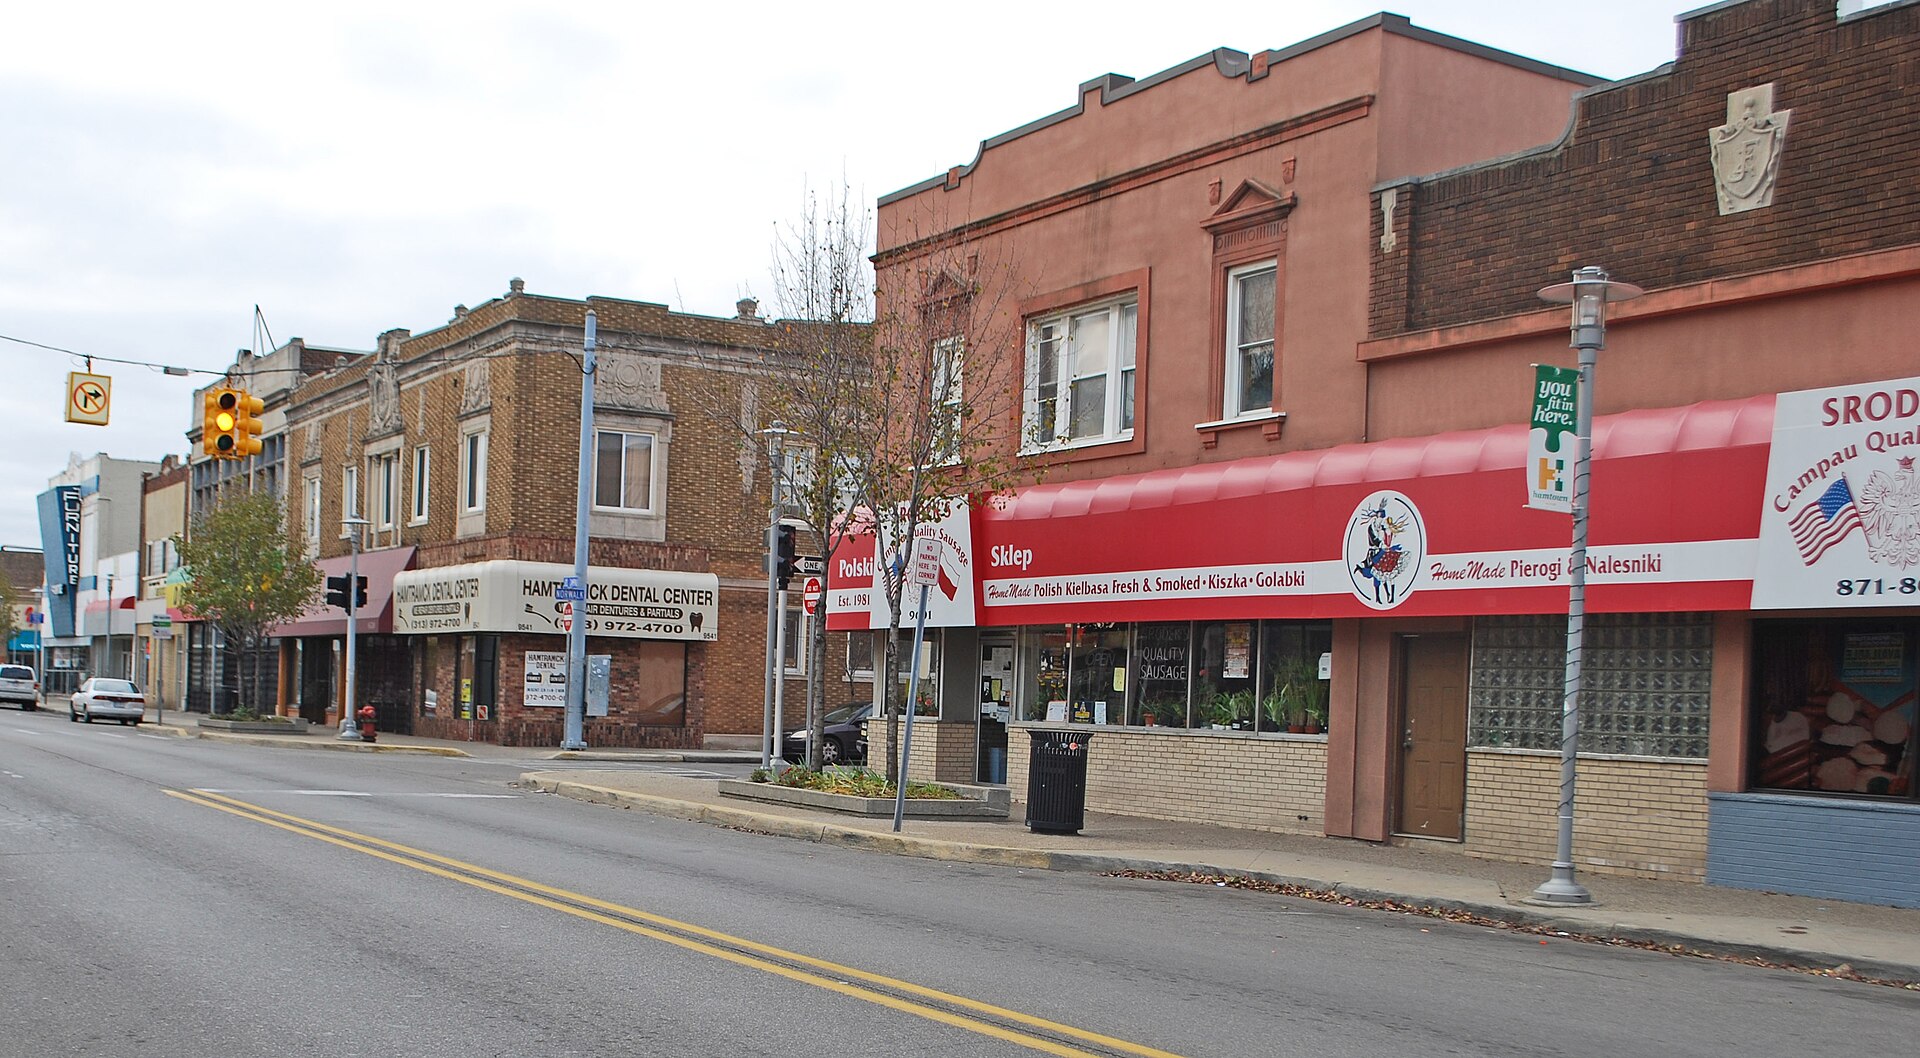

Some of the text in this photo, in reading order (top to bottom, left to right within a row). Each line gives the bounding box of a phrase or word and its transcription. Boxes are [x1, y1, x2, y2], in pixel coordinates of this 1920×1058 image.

[1538, 380, 1572, 399] you
[1546, 396, 1574, 412] fit in
[1822, 389, 1920, 427] SROD
[1534, 404, 1573, 426] here.
[1774, 444, 1858, 513] Campau
[1533, 490, 1568, 502] hamtown
[63, 491, 82, 586] FURNITURE
[913, 525, 936, 541] uality
[939, 527, 969, 568] Sausage
[804, 561, 819, 570] ONE
[919, 553, 938, 562] PARKING
[990, 544, 1033, 571] Sklep
[838, 556, 874, 578] Polski
[918, 562, 938, 571] HERE TO
[1510, 557, 1562, 582] Pierogi
[1585, 553, 1662, 576] Nalesniki
[918, 571, 936, 580] CORNER
[455, 578, 480, 599] CENTER
[1033, 582, 1062, 598] Polish
[1065, 580, 1109, 597] Kielbasa
[1112, 577, 1139, 594] Fresh
[1142, 577, 1152, 592] &
[1155, 575, 1201, 592] Smoked
[1208, 572, 1248, 590] Kiszka
[1255, 570, 1306, 588] Golabki
[1836, 577, 1920, 596] 871-8
[556, 590, 585, 600] NORWALK
[611, 585, 659, 603] DENTAL
[663, 588, 713, 606] CENTER
[838, 593, 870, 607] Est. 1981
[599, 605, 639, 617] DENTURES
[639, 607, 646, 617] &
[646, 608, 680, 619] PARTIALS
[411, 618, 428, 630] (313)
[429, 617, 461, 629] 972-4700
[518, 623, 533, 631] 9541
[605, 620, 684, 634] 972-4700
[703, 632, 717, 640] 9541
[1142, 646, 1185, 662] QUALITY
[535, 662, 557, 670] DENTAL
[1140, 664, 1186, 680] SAUSAGE
